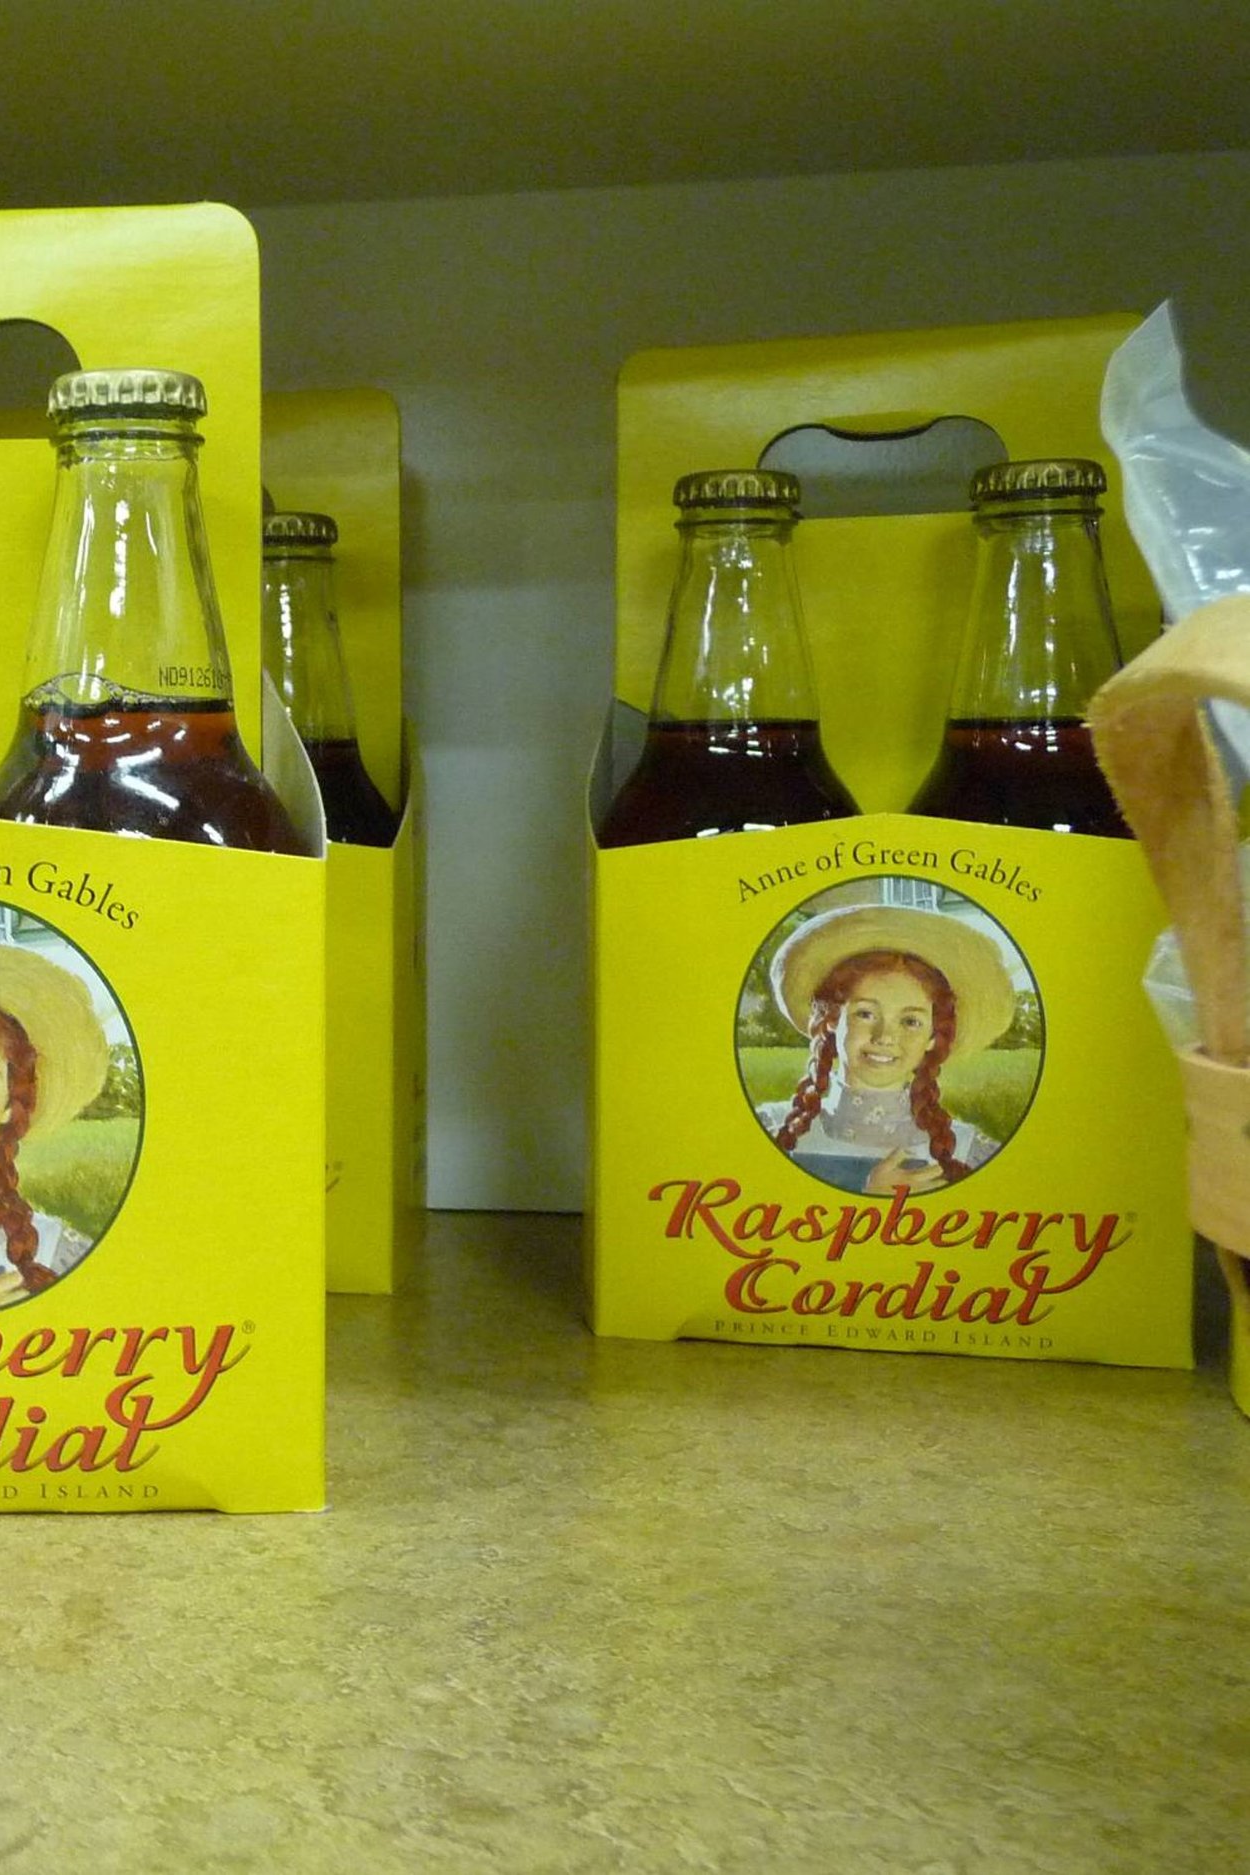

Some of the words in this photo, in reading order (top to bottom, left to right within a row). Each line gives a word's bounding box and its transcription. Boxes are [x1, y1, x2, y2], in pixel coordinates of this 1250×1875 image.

[27, 861, 140, 931] Gables
[737, 860, 808, 903] Anne
[815, 842, 845, 871] of
[852, 841, 939, 868] Green
[949, 849, 1043, 903] Gables
[648, 1178, 1134, 1295] Raspberry
[724, 1257, 1054, 1326] Cordial
[714, 1318, 811, 1337] PRINCE
[827, 1323, 936, 1344] EDWARD
[953, 1329, 1055, 1350] ISLAND
[39, 1482, 160, 1499] ISLAND
